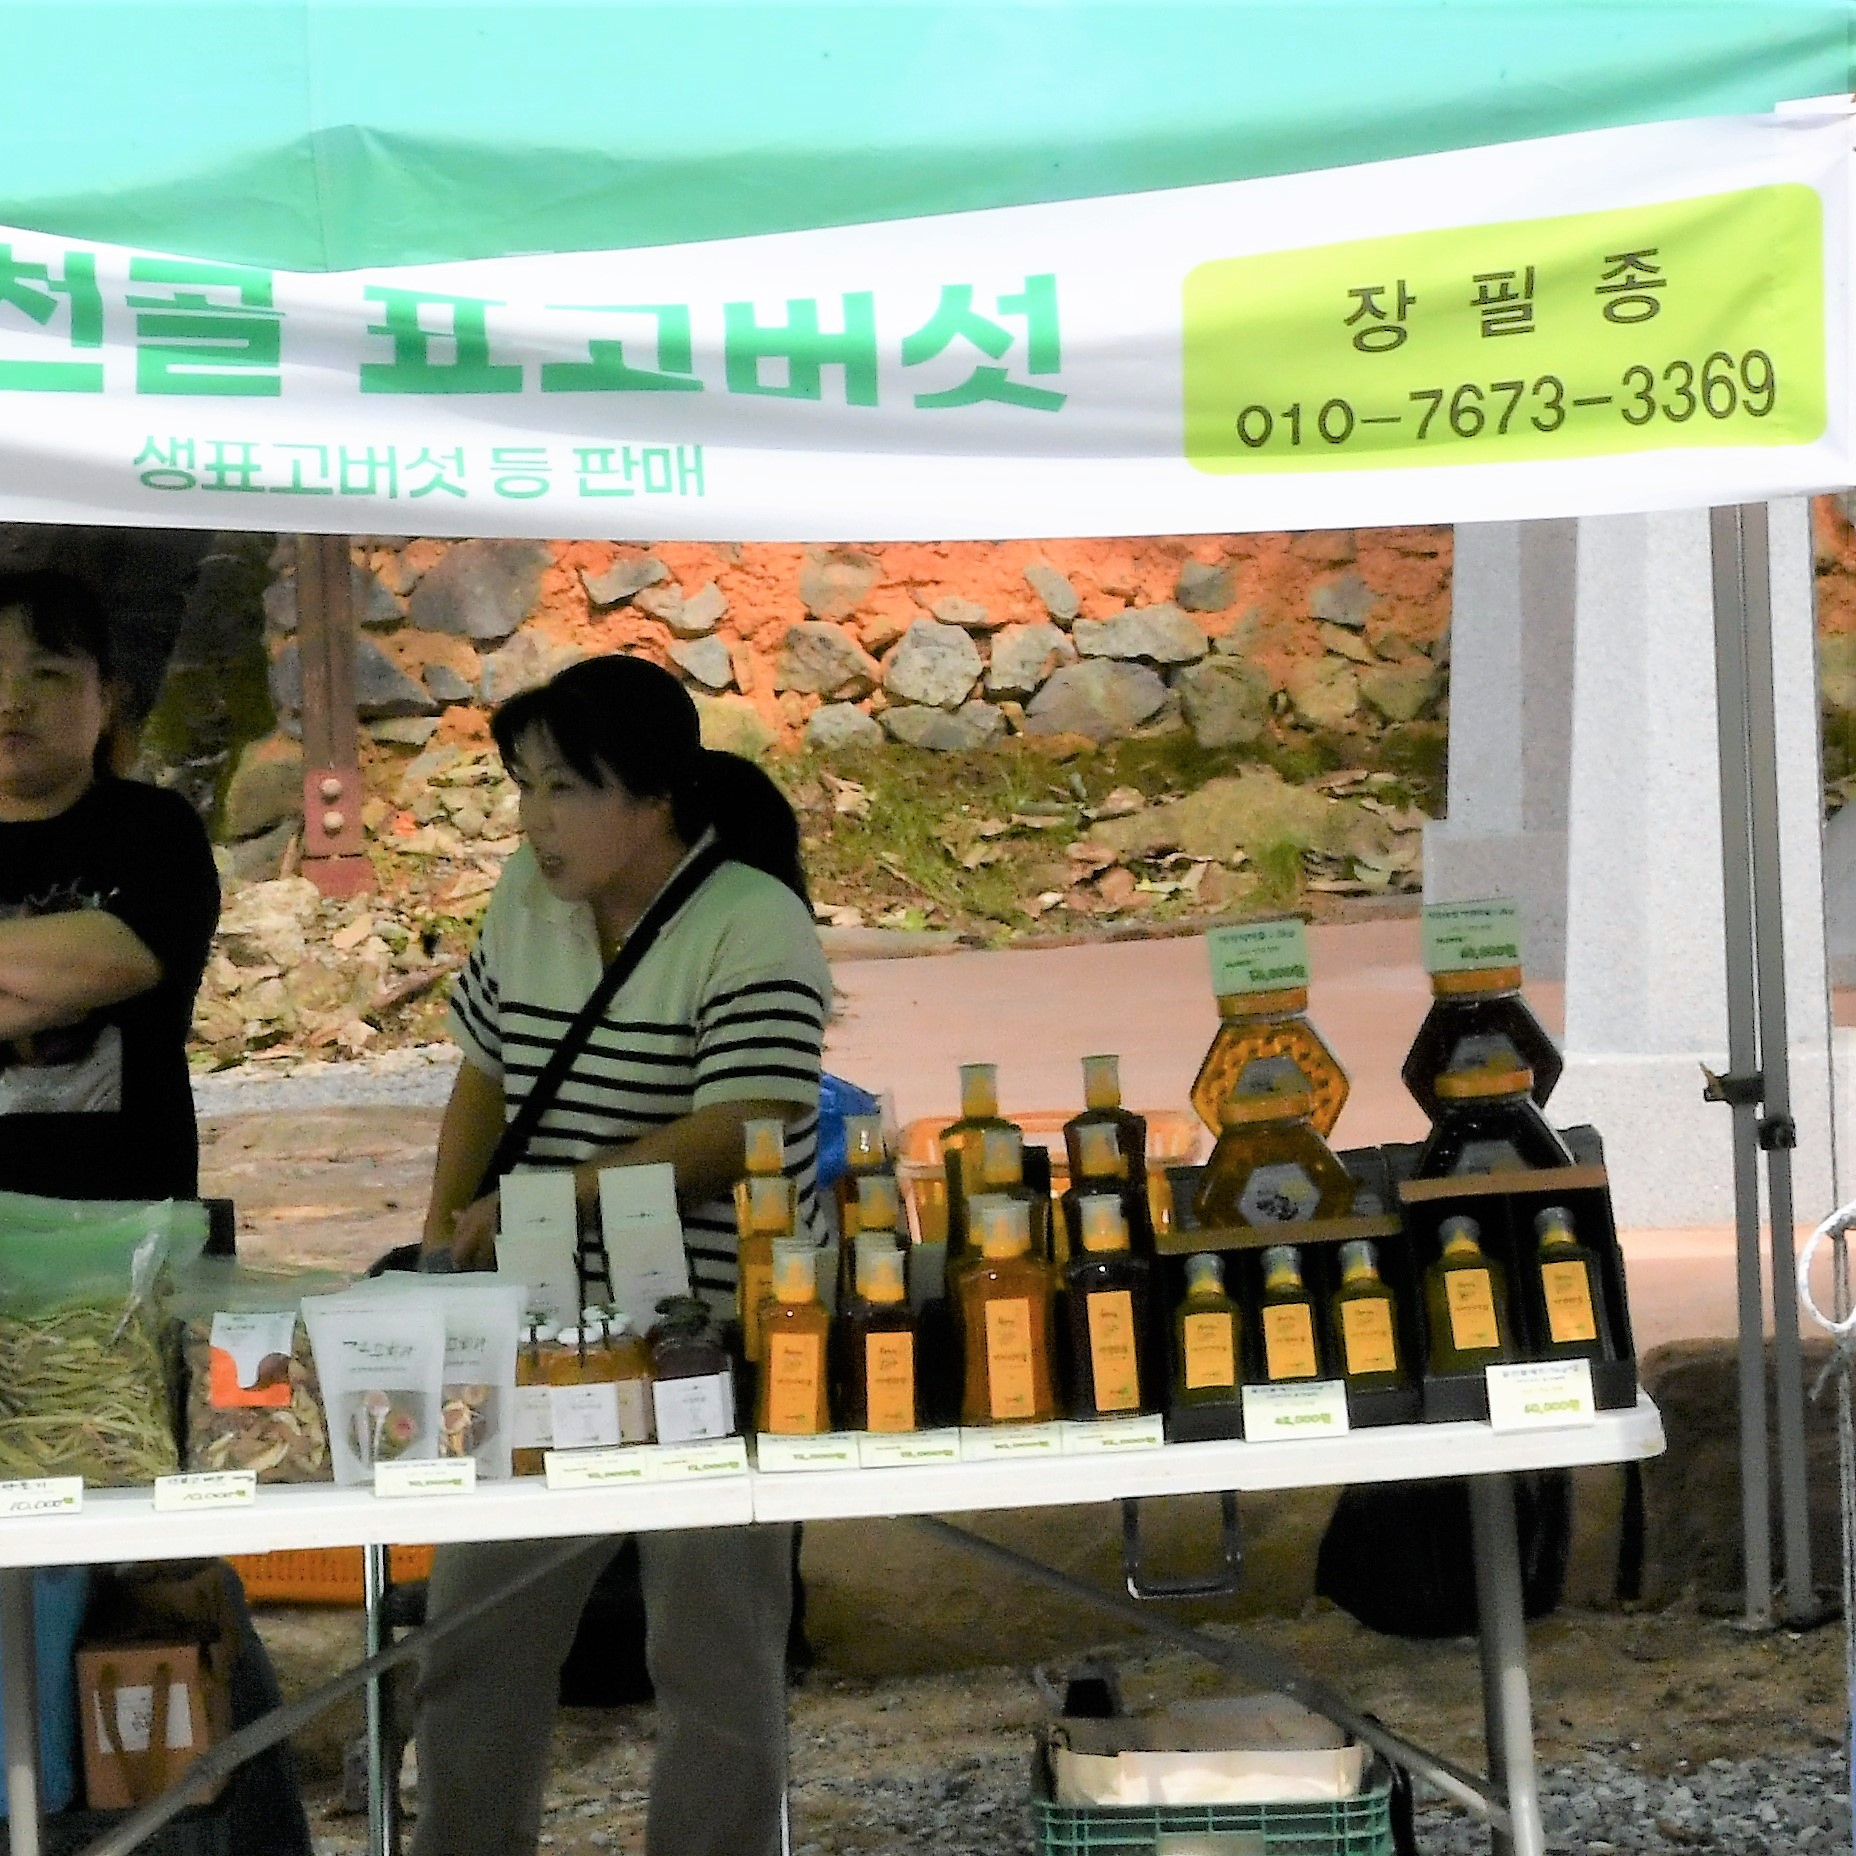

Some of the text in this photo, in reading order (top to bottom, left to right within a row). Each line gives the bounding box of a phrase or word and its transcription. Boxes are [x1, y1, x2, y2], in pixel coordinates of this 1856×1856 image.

[359, 272, 1068, 413] 표고버섯
[1235, 348, 1777, 450] 010-7673-3369
[133, 434, 706, 500] 생표고버섯 등 판매
